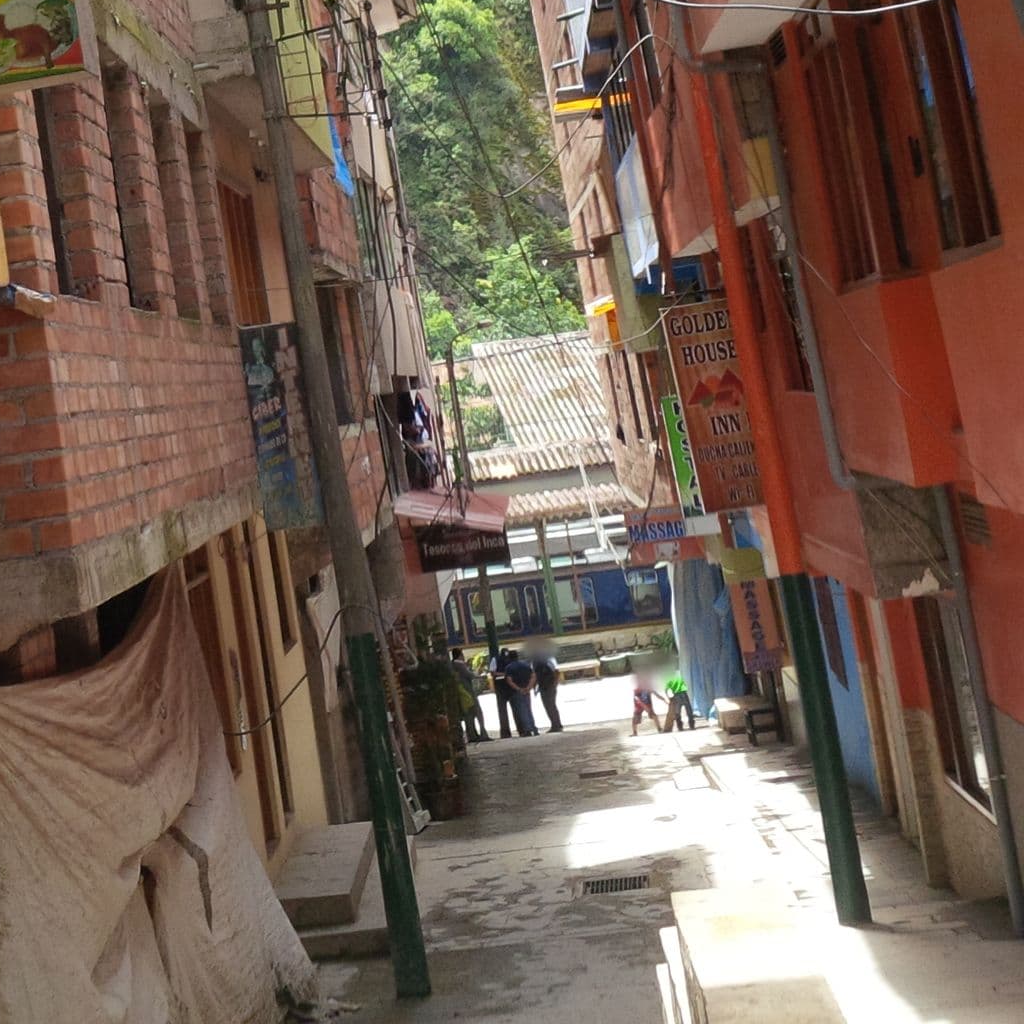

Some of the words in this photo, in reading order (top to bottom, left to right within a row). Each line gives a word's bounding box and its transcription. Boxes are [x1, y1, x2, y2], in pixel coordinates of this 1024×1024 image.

[670, 309, 731, 337] GOLDE
[681, 339, 736, 366] HOUSE
[710, 413, 742, 436] INN
[482, 534, 505, 551] Inca
[627, 519, 686, 544] MASSAG
